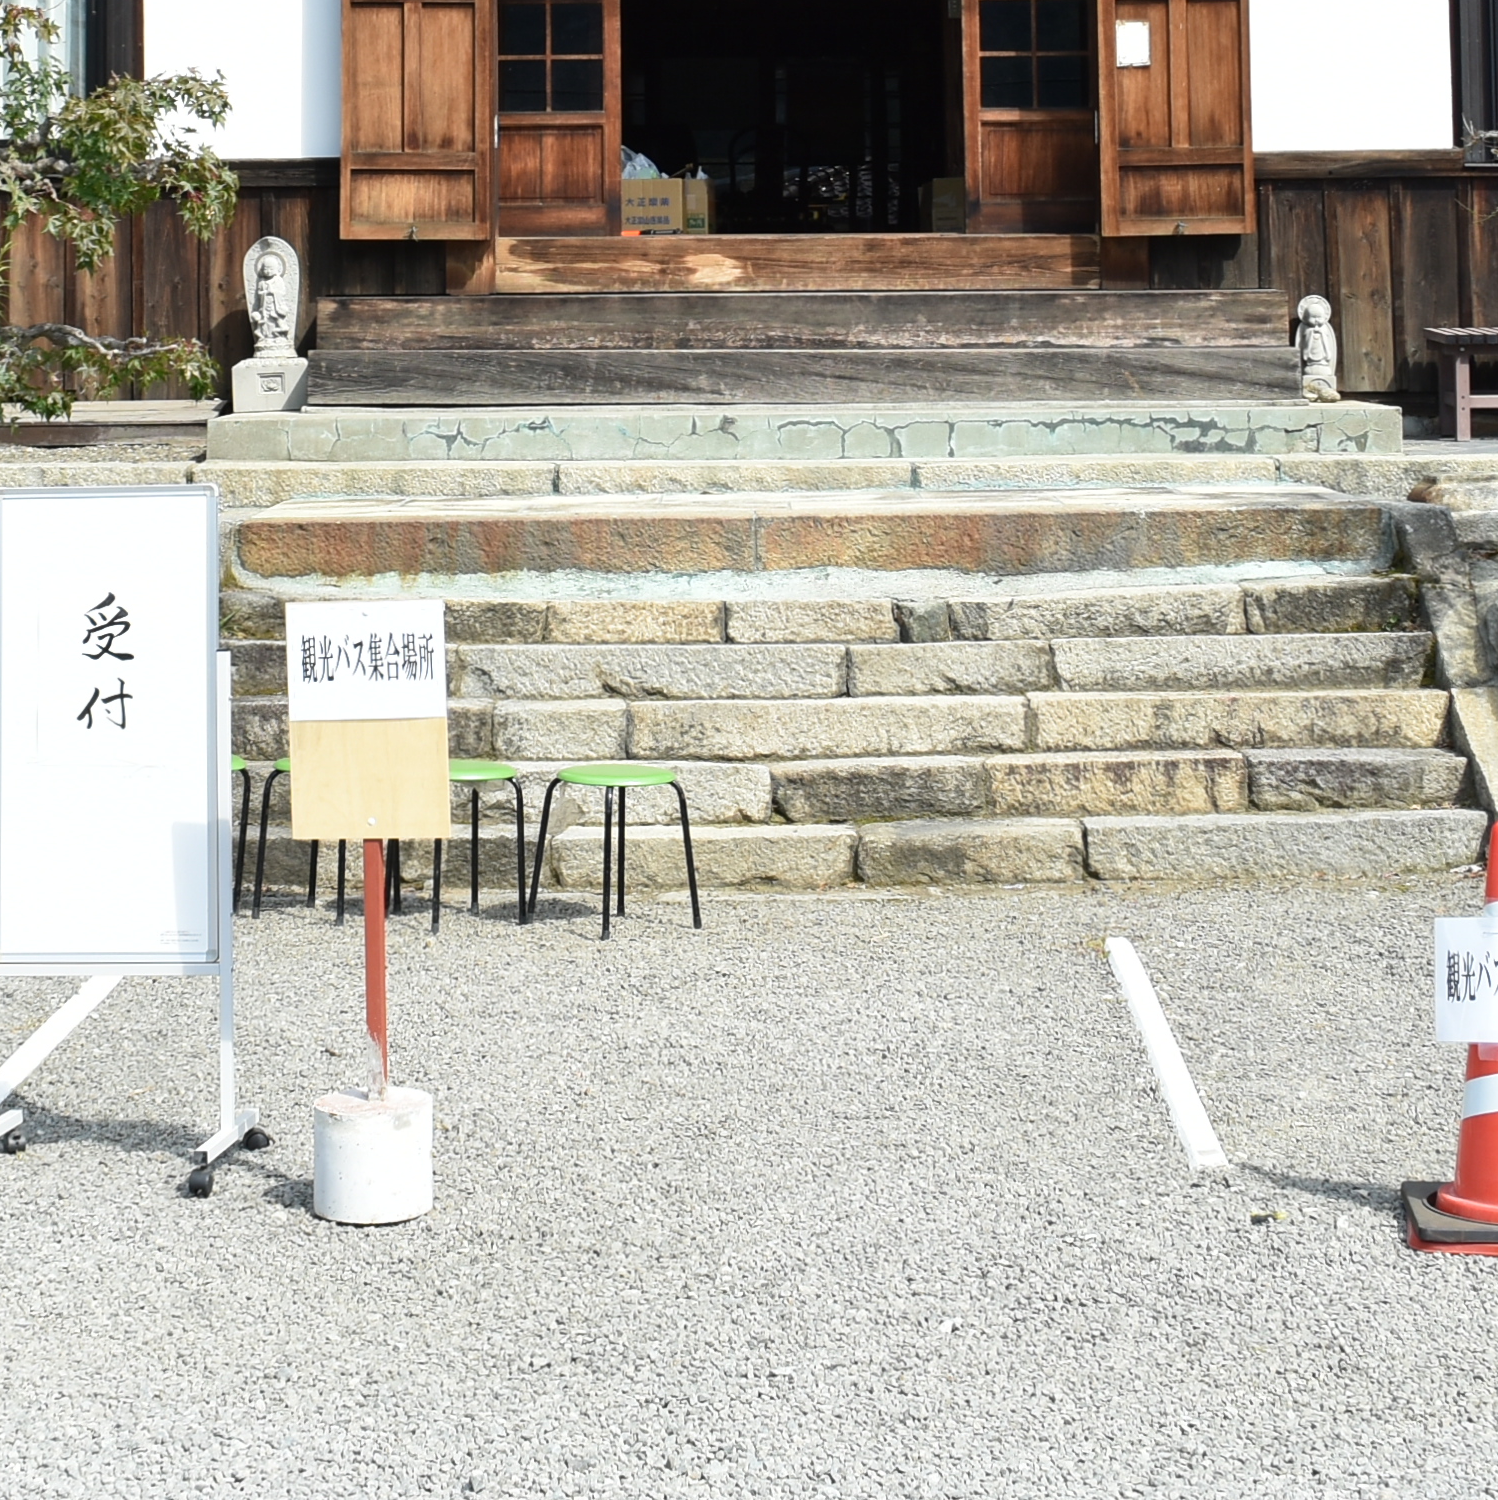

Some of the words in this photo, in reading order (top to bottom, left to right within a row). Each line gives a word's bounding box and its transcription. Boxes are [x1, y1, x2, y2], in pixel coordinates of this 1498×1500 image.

[77, 591, 135, 730] 受付
[300, 632, 436, 685] 観光バス集合場所
